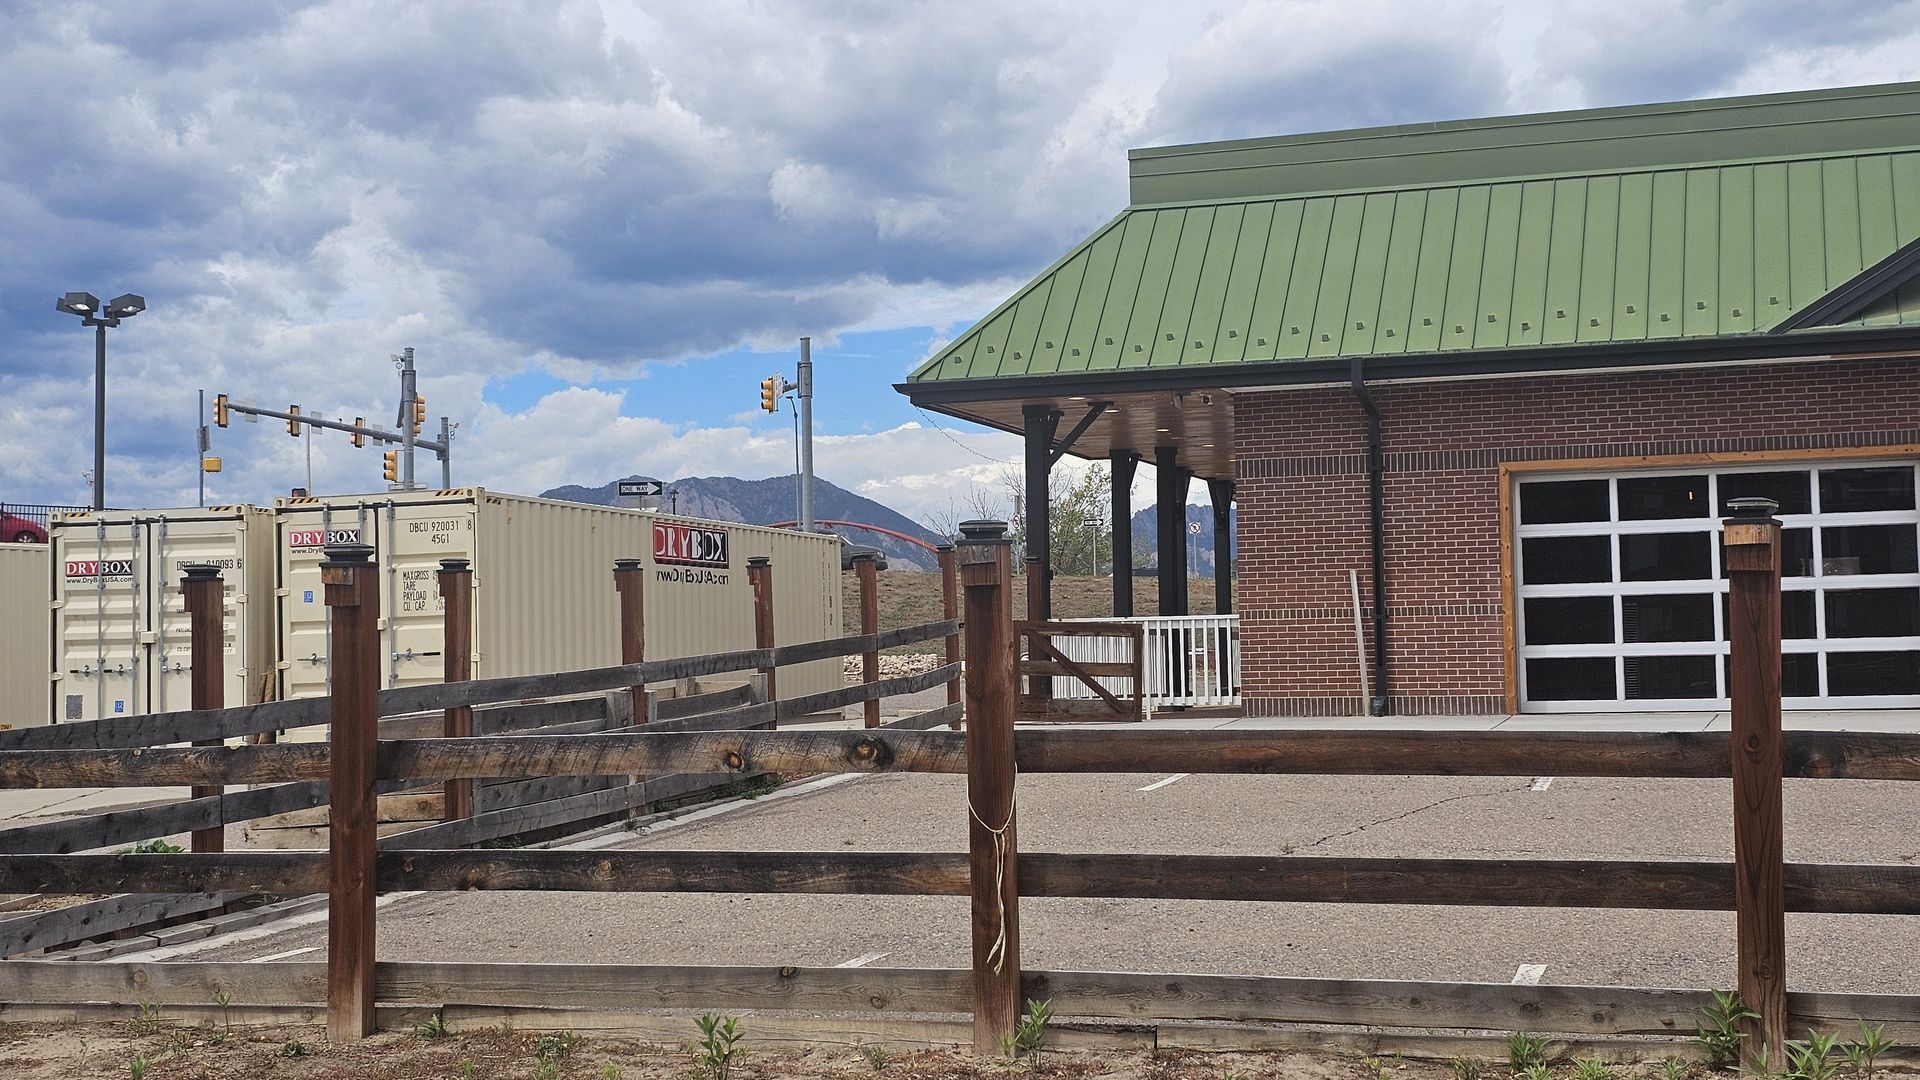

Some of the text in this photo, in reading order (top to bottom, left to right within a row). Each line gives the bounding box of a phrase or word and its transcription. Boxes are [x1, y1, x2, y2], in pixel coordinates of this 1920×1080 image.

[409, 519, 473, 533] DBCU 920031 8
[431, 533, 450, 544] 45G1
[237, 558, 243, 569] 6
[402, 581, 417, 591] TARE
[402, 591, 427, 602] PAYLOAD
